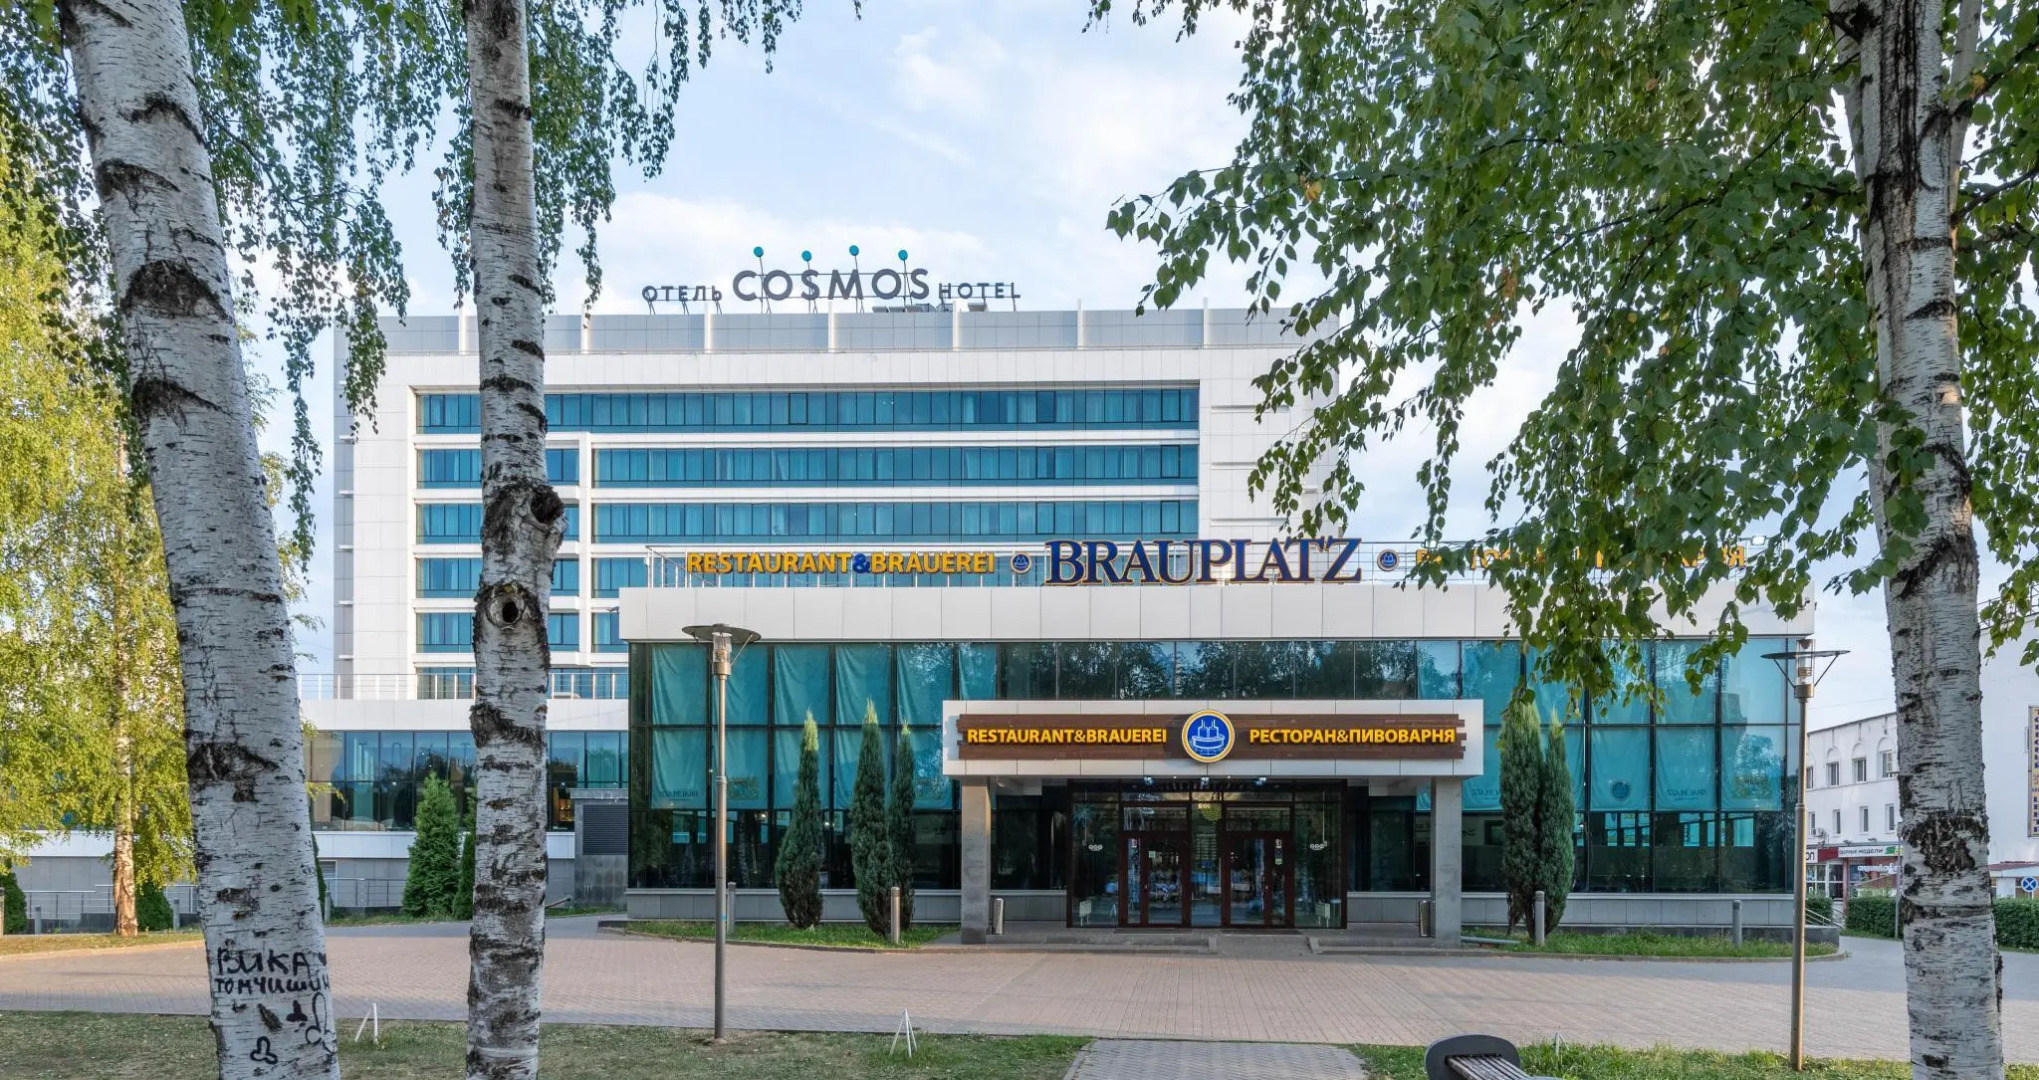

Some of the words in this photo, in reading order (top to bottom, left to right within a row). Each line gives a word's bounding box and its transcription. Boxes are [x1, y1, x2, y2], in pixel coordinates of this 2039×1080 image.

[641, 285, 723, 301] ОТЕЛЬ
[732, 268, 930, 301] COSMOS
[938, 282, 1021, 299] HOTEL
[687, 552, 996, 574] RESTAURANT&BRAUEREI
[1044, 538, 1363, 586] BRAUPLATZ
[967, 728, 1167, 743] RESTAURANT&BRAUEREI
[1249, 728, 1456, 743] РЕСТОРАН&ПИВОВАРНЯ
